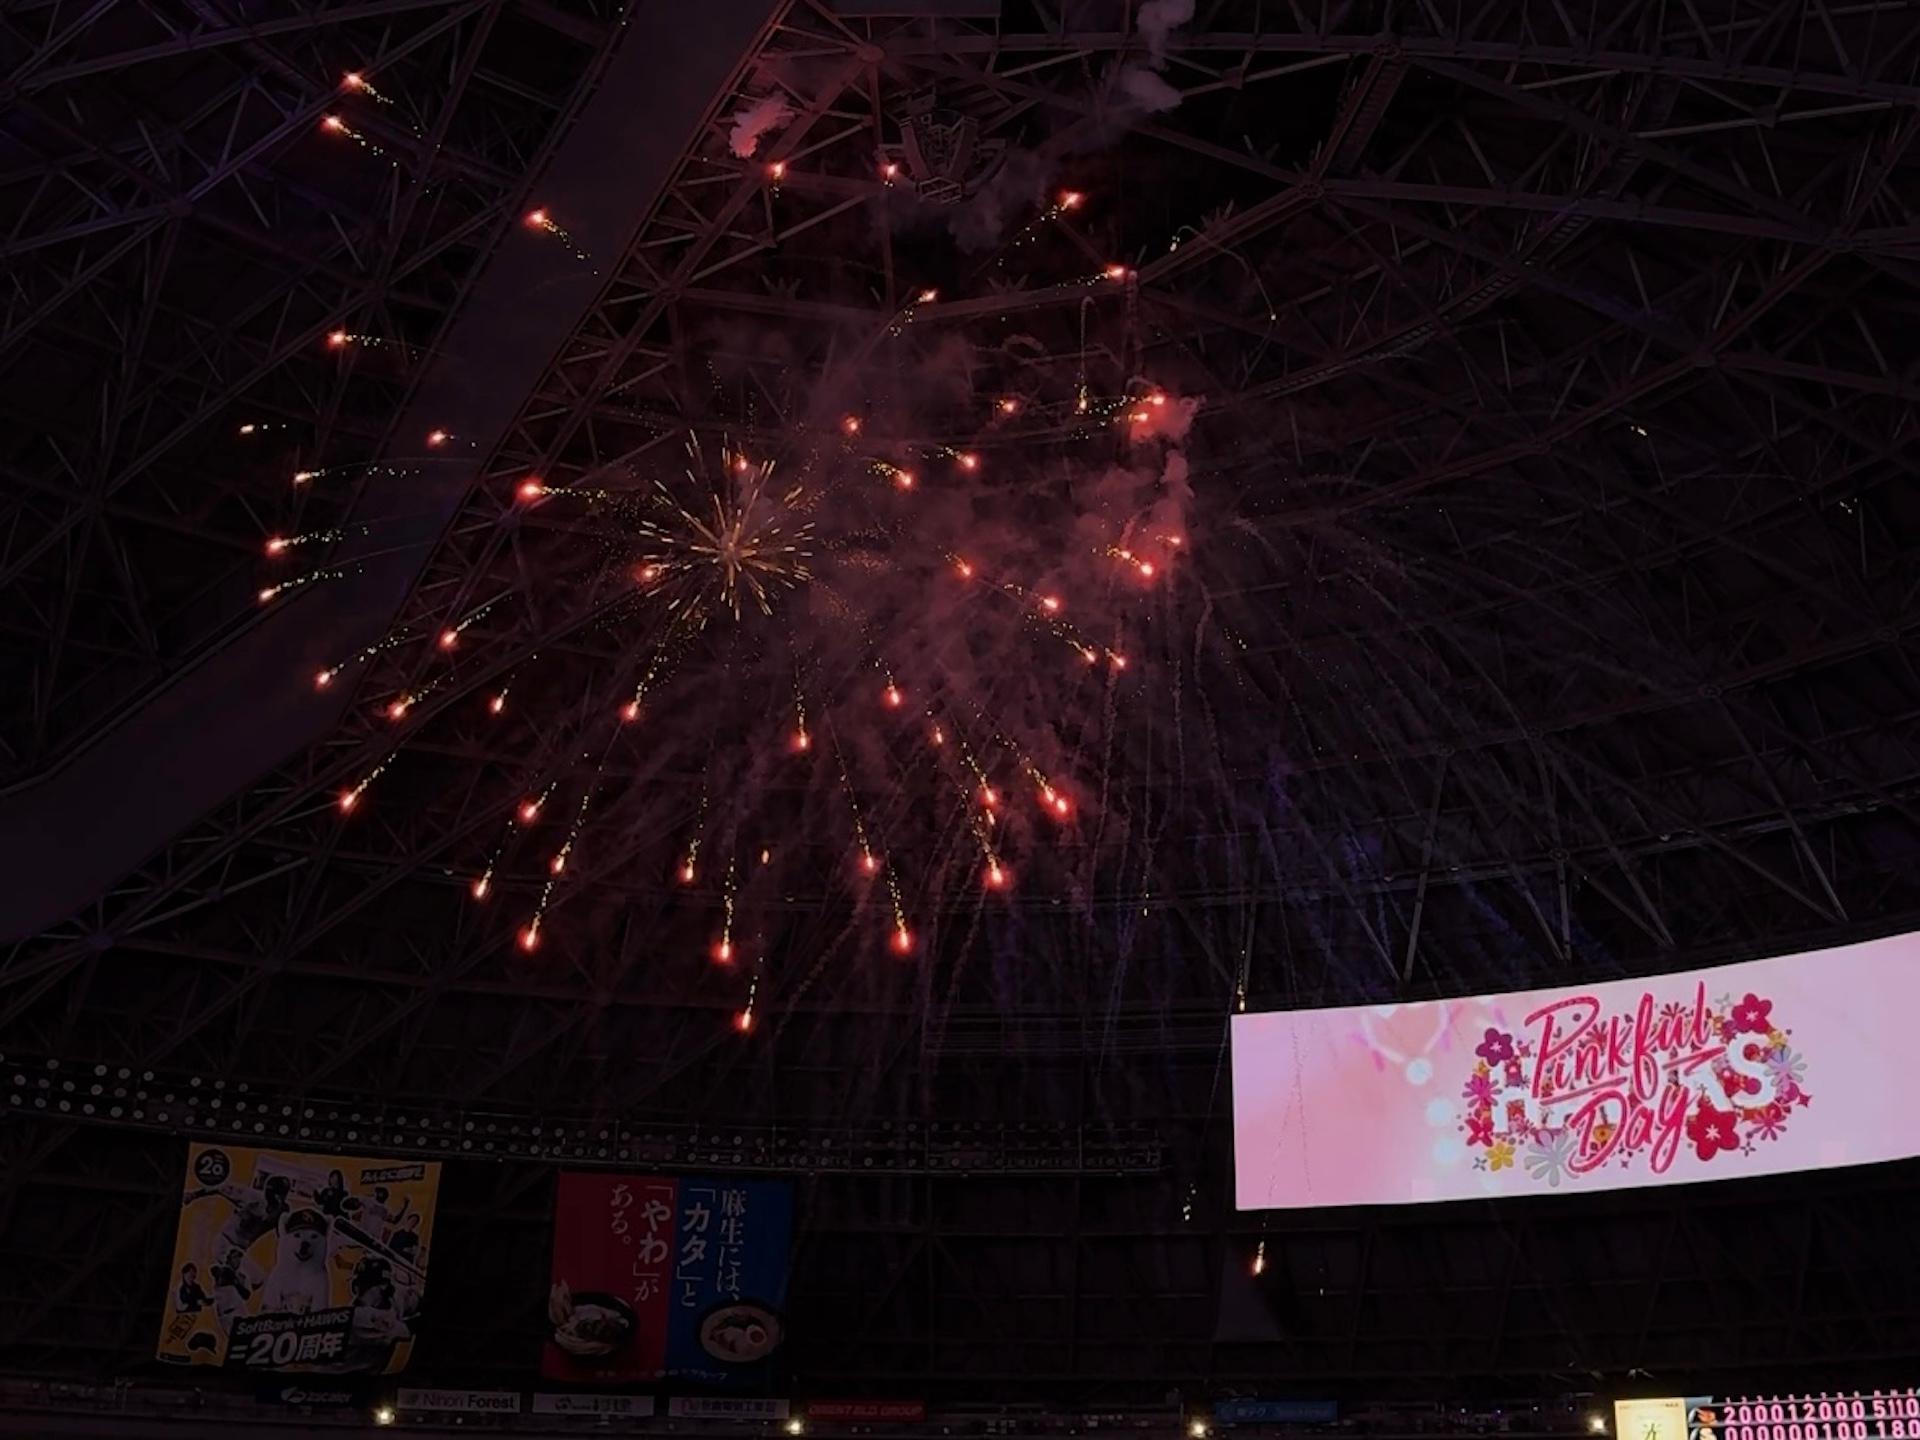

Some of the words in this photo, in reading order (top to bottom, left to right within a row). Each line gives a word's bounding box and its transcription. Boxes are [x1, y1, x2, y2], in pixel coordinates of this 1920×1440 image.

[1524, 979, 1714, 1100] Pinkful
[1567, 1083, 1691, 1174] Day
[609, 1183, 633, 1245] ある。
[633, 1184, 673, 1303] 「やわ」が
[676, 1187, 717, 1308] 「カタ」と
[717, 1188, 747, 1301] 麻生には、
[423, 1392, 465, 1408] Nihon
[467, 1394, 514, 1409] Forest
